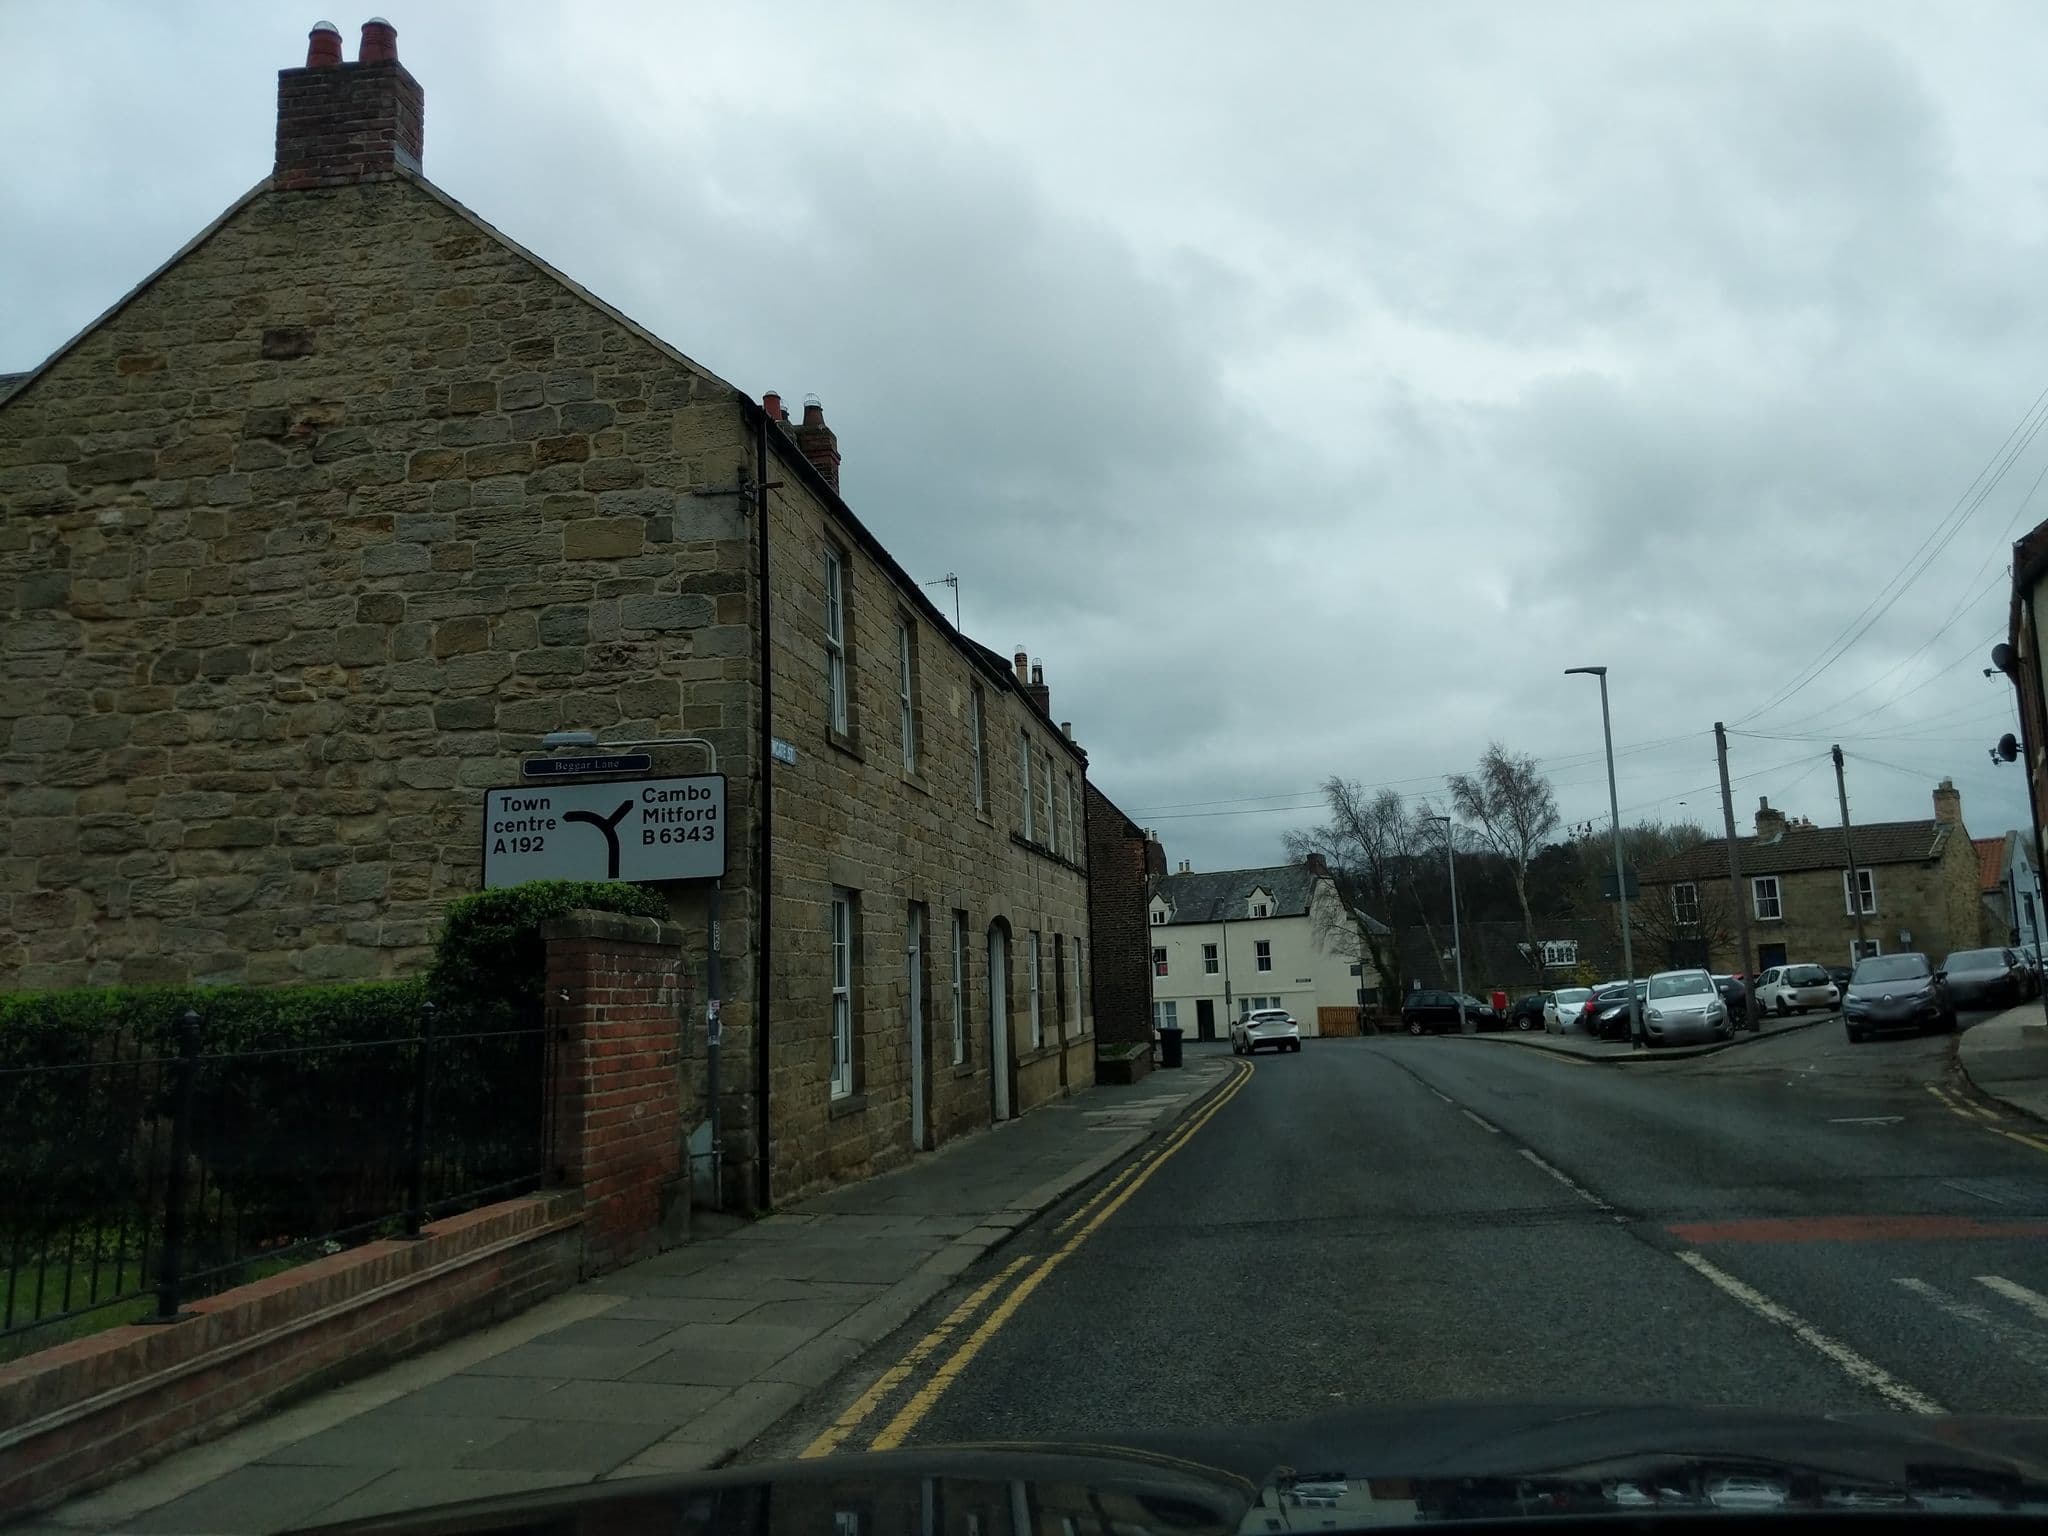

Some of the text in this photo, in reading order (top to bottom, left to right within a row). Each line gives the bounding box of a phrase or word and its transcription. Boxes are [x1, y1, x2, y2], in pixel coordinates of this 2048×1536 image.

[555, 760, 620, 772] Beggar Lane
[500, 796, 550, 812] Town
[642, 785, 711, 804] Cambo
[642, 805, 717, 824] Mitford
[493, 815, 557, 834] centre
